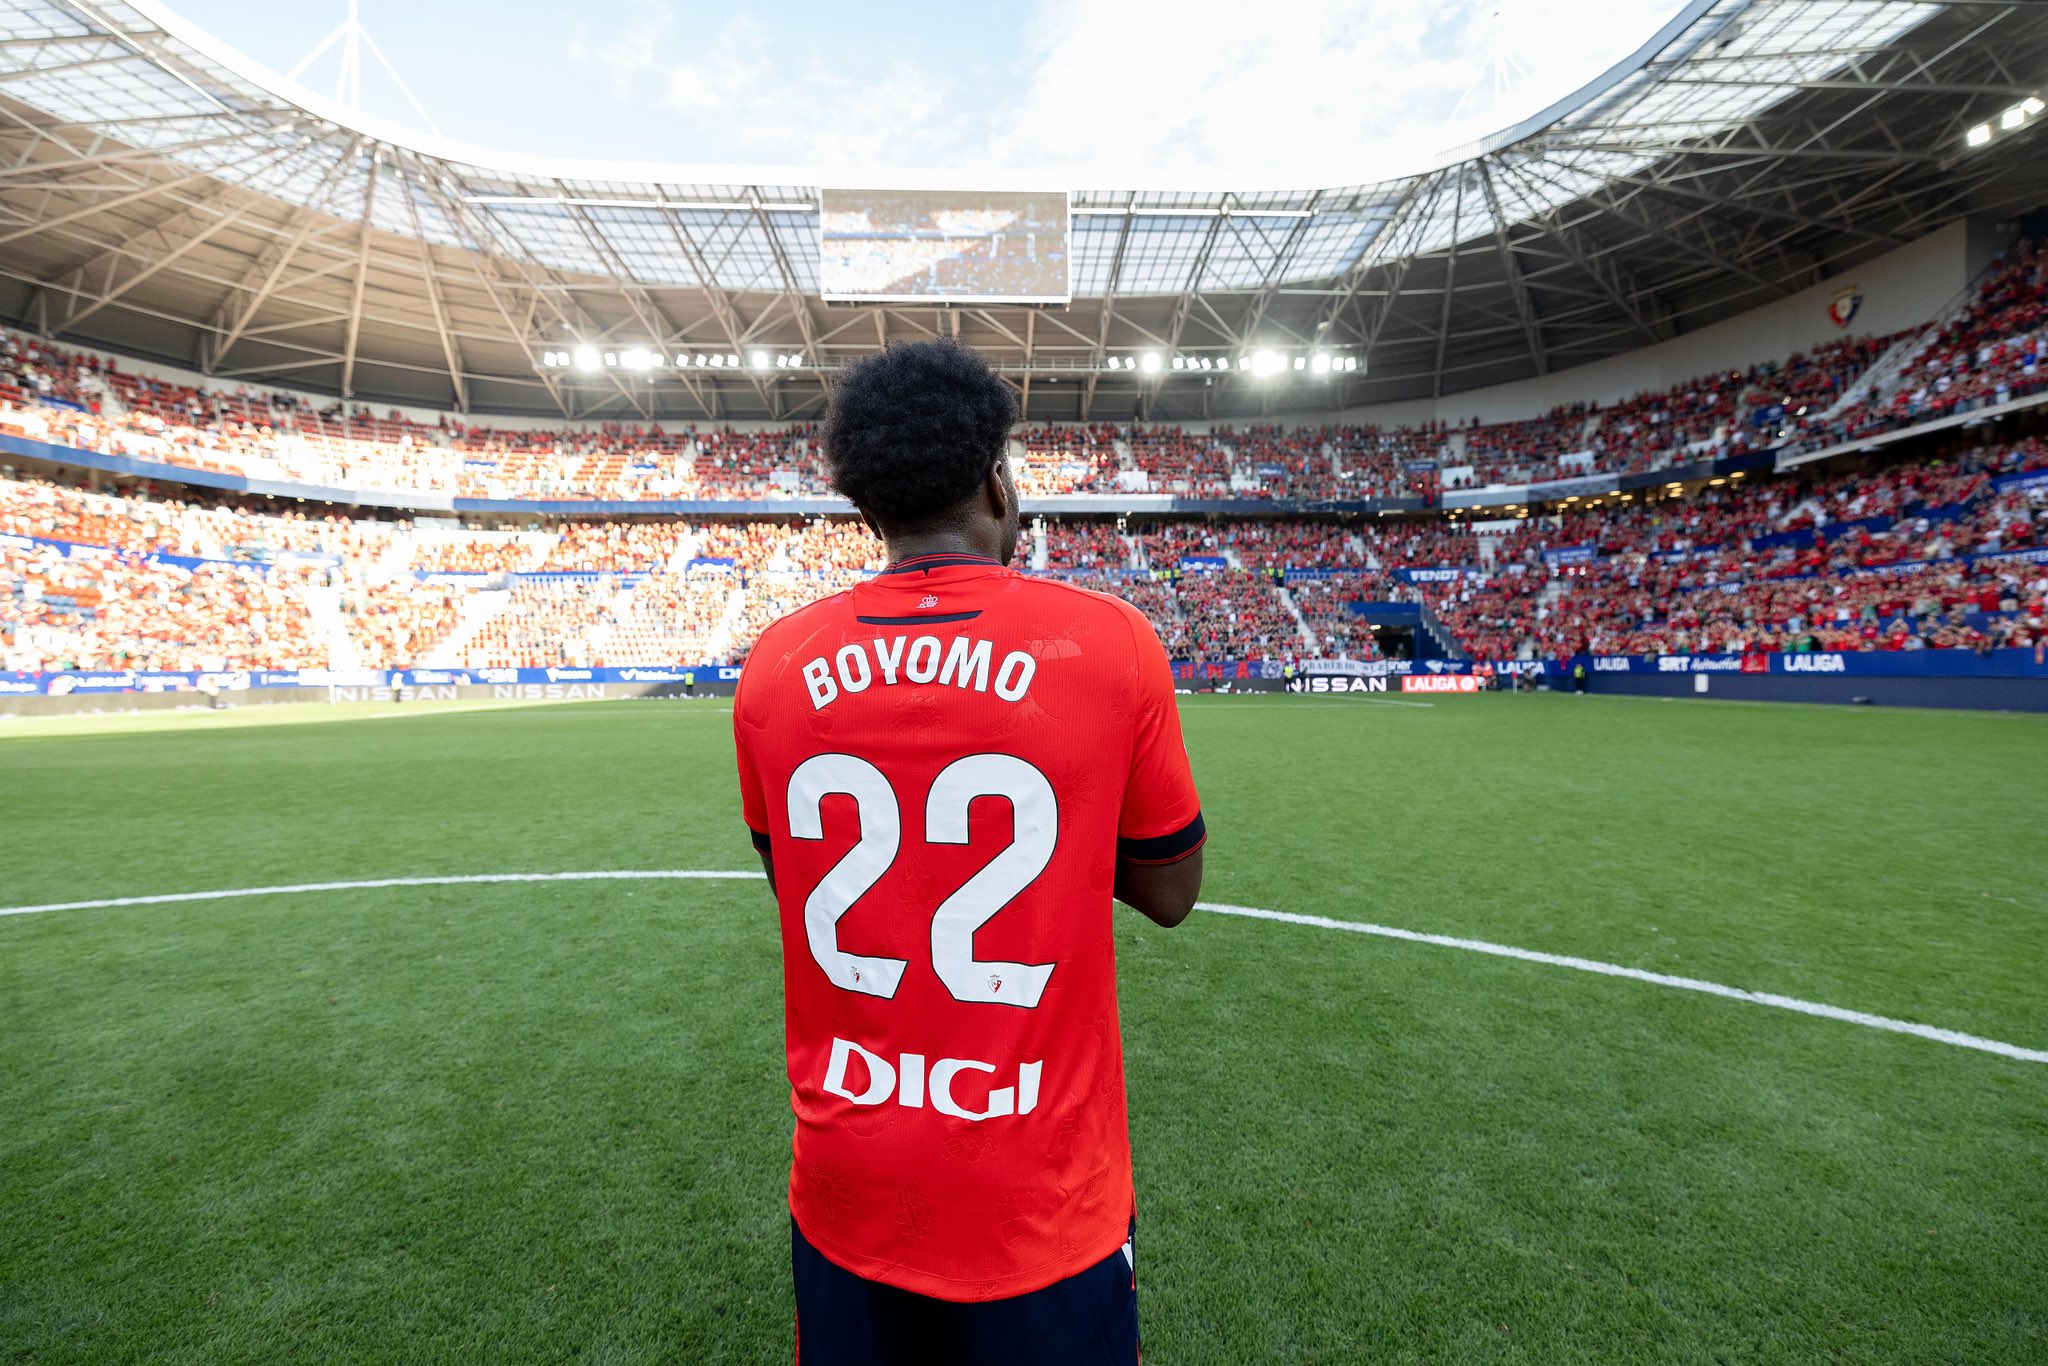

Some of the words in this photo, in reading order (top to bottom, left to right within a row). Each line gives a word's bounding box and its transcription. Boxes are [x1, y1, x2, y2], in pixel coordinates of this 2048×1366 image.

[1593, 657, 1630, 671] LALIGA
[1784, 655, 1845, 672] LALIGA
[802, 635, 1036, 711] BOYOMO
[335, 685, 458, 701] NISSAN
[494, 683, 605, 700] NISSAN
[1285, 677, 1387, 692] NISSAN
[1405, 677, 1458, 692] LALIGA
[787, 752, 1058, 1009] 22
[823, 1037, 1044, 1121] DIGI
